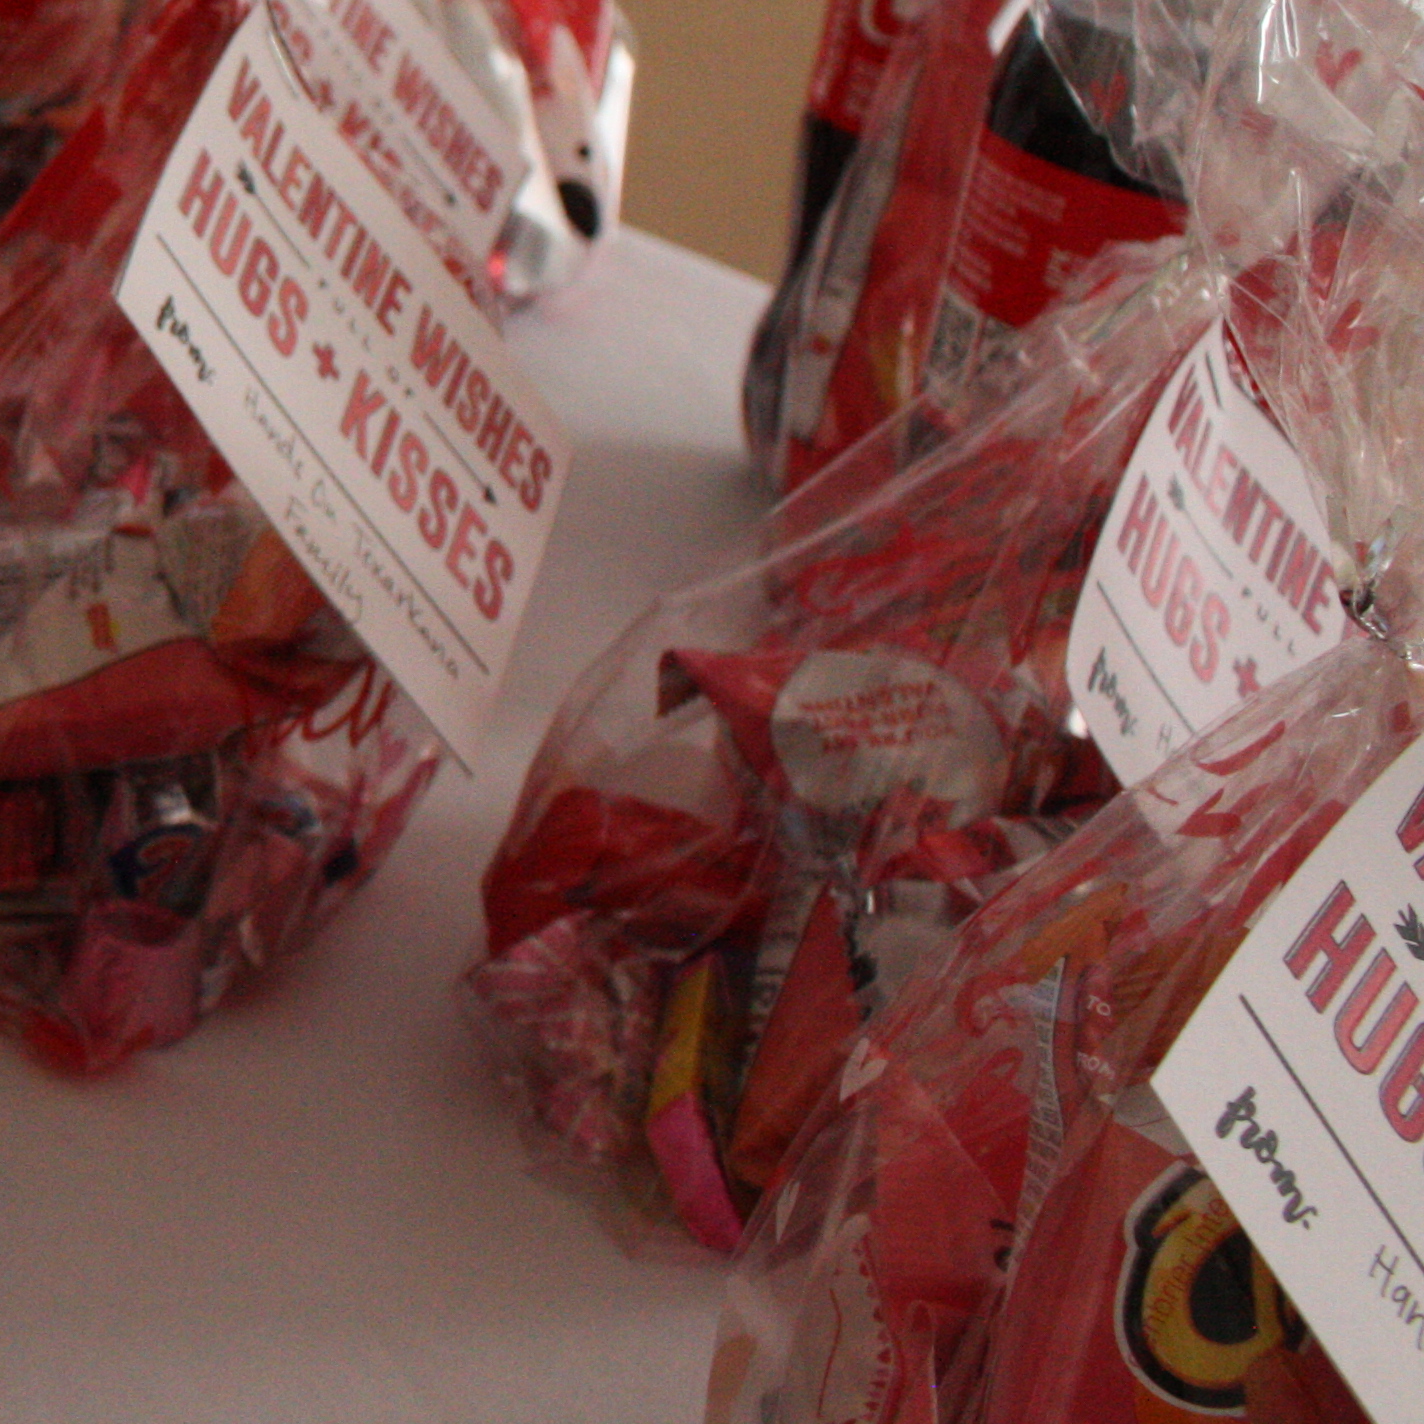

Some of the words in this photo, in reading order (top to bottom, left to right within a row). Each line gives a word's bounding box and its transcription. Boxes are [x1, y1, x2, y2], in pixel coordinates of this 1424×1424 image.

[178, 147, 310, 359] HUGS
[339, 370, 517, 622] KISSES
[227, 55, 412, 337] VALENTINE
[410, 303, 552, 513] WISHES
[1118, 472, 1231, 684] HUGS
[1167, 363, 1336, 637] VALENTINE
[1086, 994, 1112, 1017] TO
